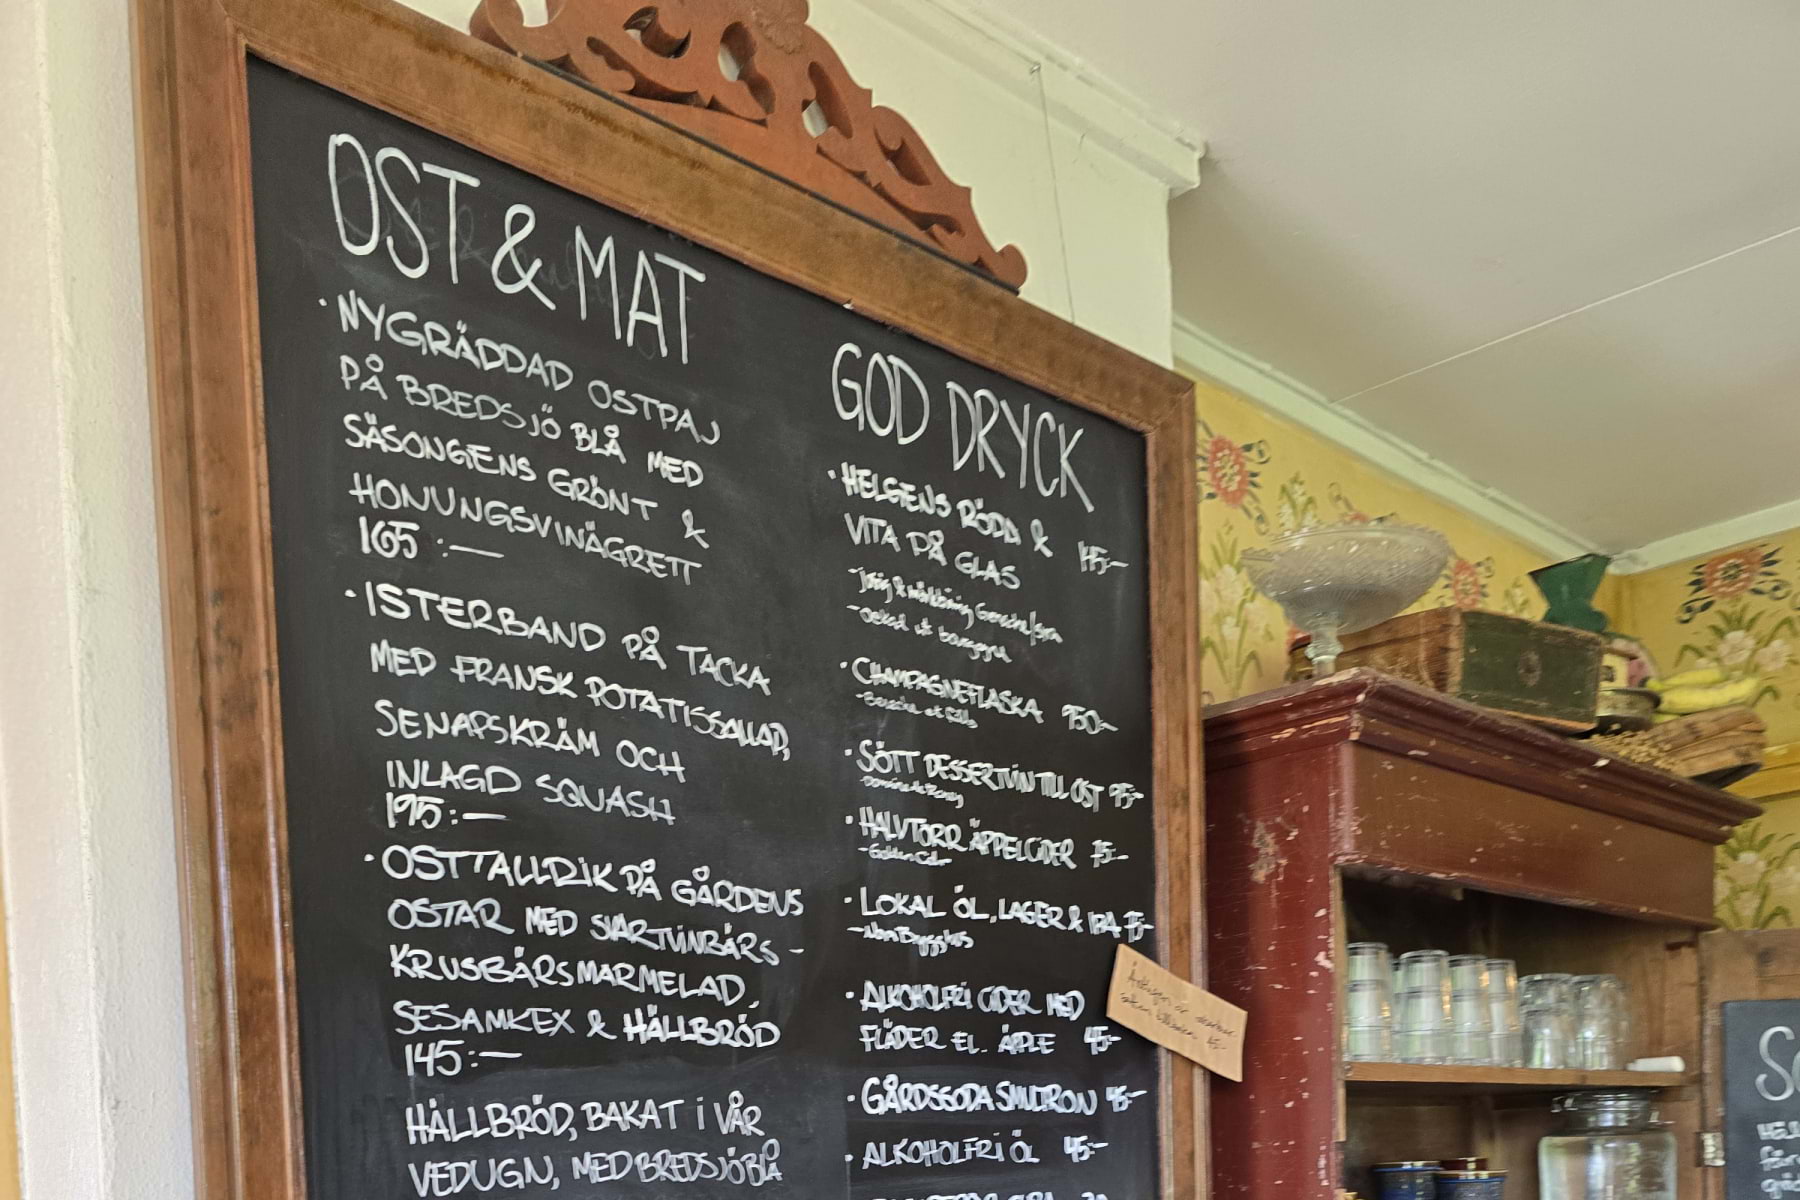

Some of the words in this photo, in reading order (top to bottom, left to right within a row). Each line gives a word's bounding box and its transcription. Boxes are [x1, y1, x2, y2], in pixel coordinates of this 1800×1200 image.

[328, 133, 480, 284] OST
[491, 204, 556, 310] &
[576, 225, 706, 364] MAT
[337, 290, 573, 390] NYGRÄDDAD
[587, 380, 721, 446] OSTPAJ
[340, 354, 388, 400] PÅ
[396, 374, 562, 440] BREDSJÖ
[570, 422, 627, 464] BLÅ
[647, 451, 704, 488] MED
[831, 342, 930, 445] GOD
[945, 380, 1096, 514] DRYCK
[343, 411, 537, 482] SÄSONGENS
[547, 468, 659, 521] GRÖNT
[681, 510, 710, 549] &
[840, 462, 952, 518] HELGENS
[956, 497, 1023, 546] RÖDA
[1030, 518, 1054, 558] &
[349, 472, 703, 586] HONUNGSVINÄGRETT
[844, 512, 902, 553] VITA
[905, 529, 949, 567] PÅ
[953, 550, 1022, 591] GLAS
[364, 581, 607, 652] ISTERBAND
[621, 625, 668, 671] PÅ
[676, 644, 773, 697] TACKA
[370, 639, 438, 677] MED
[450, 654, 579, 700] FRANSK
[374, 699, 601, 757] SENAPSKRÄM
[615, 738, 687, 785] OCH
[856, 739, 922, 775] SÖTT
[1035, 771, 1071, 800] TILL
[1070, 777, 1106, 814] OST
[386, 759, 523, 796] INLAGD
[535, 773, 676, 826] SQUASH
[858, 806, 969, 853] HALVTORR
[381, 844, 619, 893] OSTTALLRIK
[619, 858, 663, 902] PÅ
[671, 865, 805, 918] GÅRDENS
[387, 898, 516, 936] OSTAR
[526, 905, 579, 938] MED
[860, 886, 948, 919] LOKAL
[998, 898, 1068, 931] LAGER
[1066, 904, 1085, 934] &
[586, 1008, 618, 1041] &
[623, 1003, 782, 1048] HÄLLBRÖD
[859, 1018, 948, 1053] FLÄDER
[1045, 989, 1086, 1022] MED
[580, 1098, 685, 1132] BAKAT
[713, 1090, 766, 1137] VÅR
[1009, 1129, 1042, 1164] ÖL
[571, 1151, 634, 1184] MED
